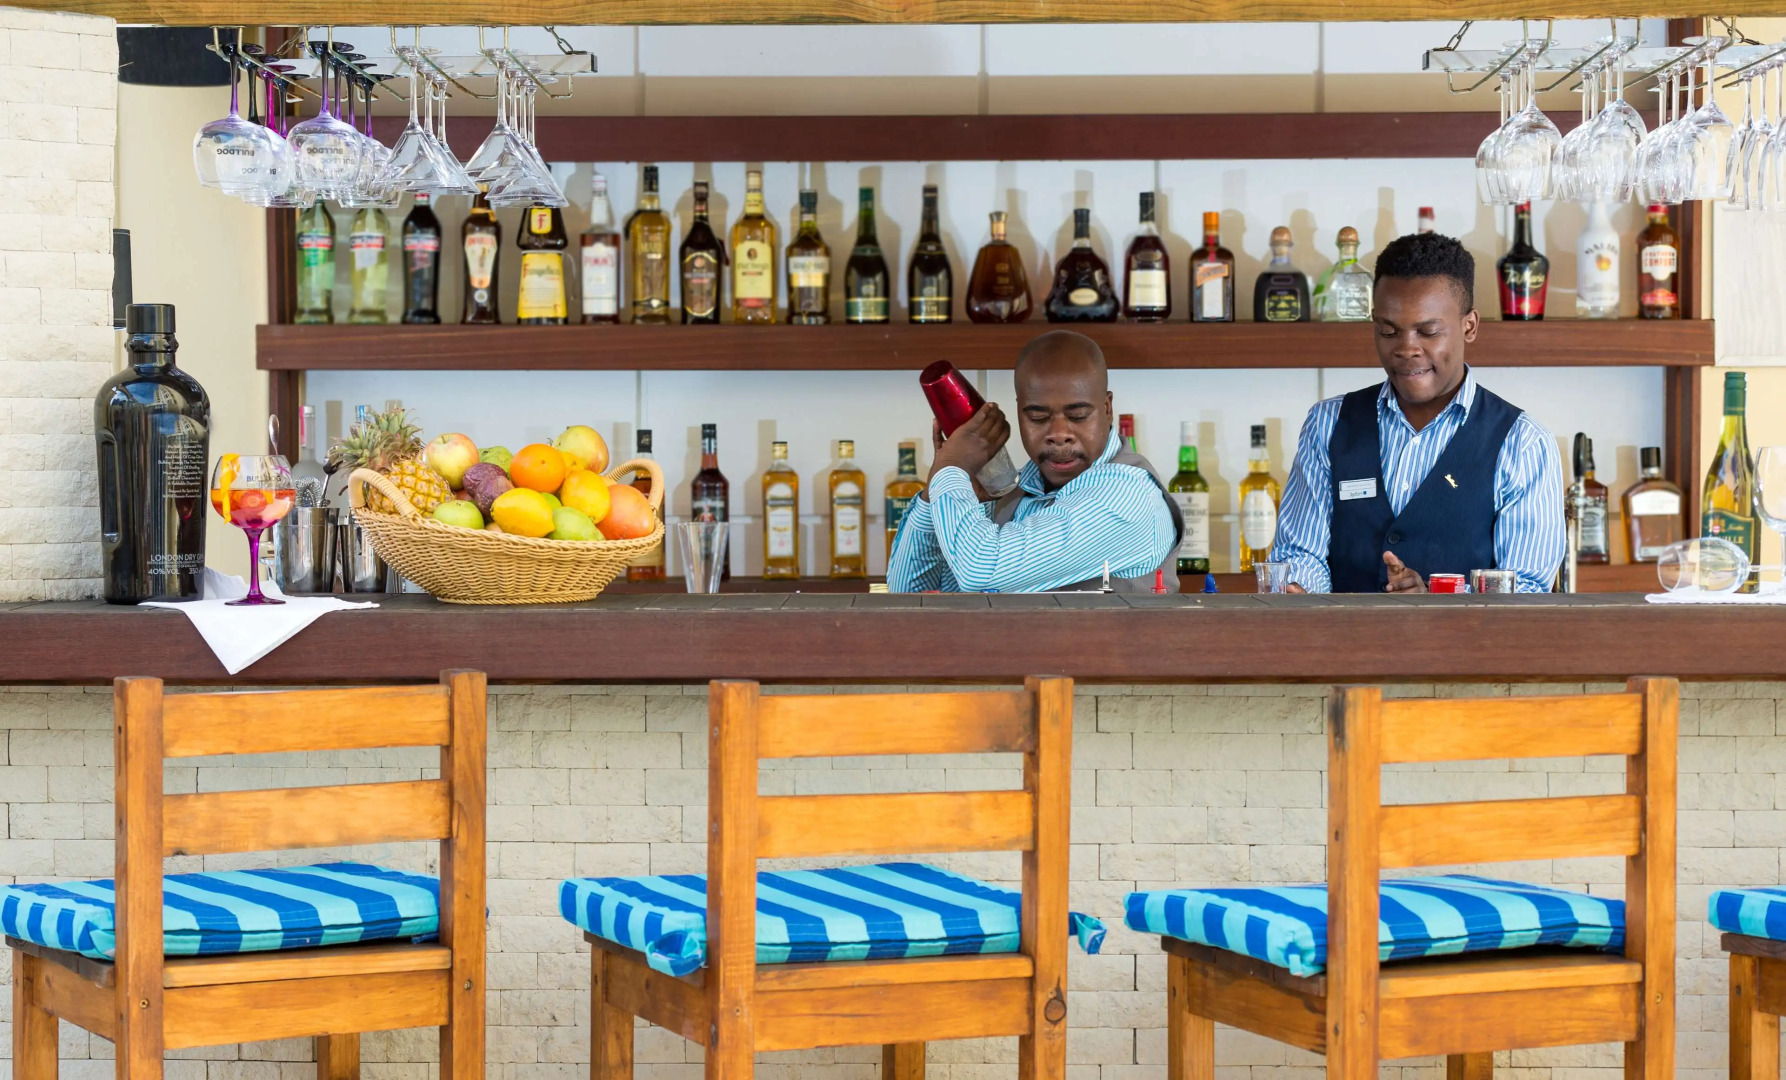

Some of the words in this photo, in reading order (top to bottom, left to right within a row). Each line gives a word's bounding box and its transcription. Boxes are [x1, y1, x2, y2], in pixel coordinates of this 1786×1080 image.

[216, 148, 255, 157] BULLDOG
[306, 147, 344, 155] BULLDOG
[1644, 258, 1675, 267] COMFORT
[1186, 528, 1193, 536] 10
